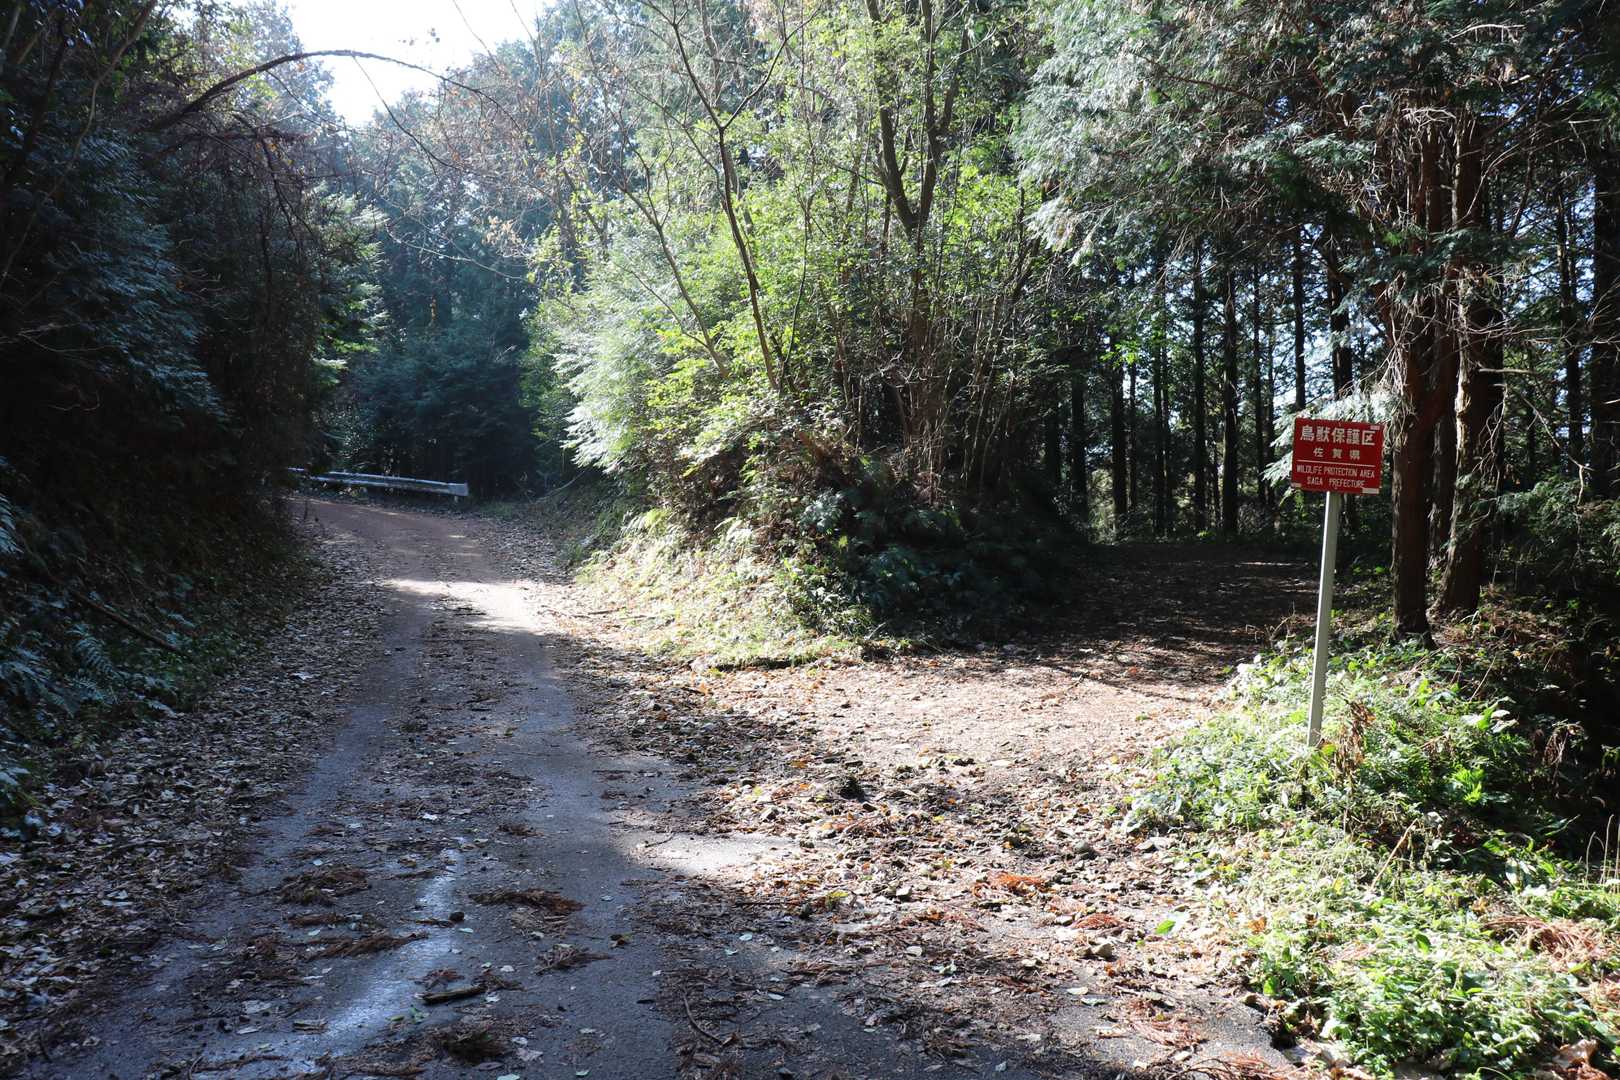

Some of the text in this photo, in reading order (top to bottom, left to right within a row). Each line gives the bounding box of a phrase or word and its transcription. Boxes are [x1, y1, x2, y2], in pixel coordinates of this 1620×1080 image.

[1300, 425, 1376, 446] 鳥獣保護区
[1297, 465, 1375, 478] WILDLIFE PROTECTION AREA
[1307, 477, 1366, 488] SAGA PREFECTURE
